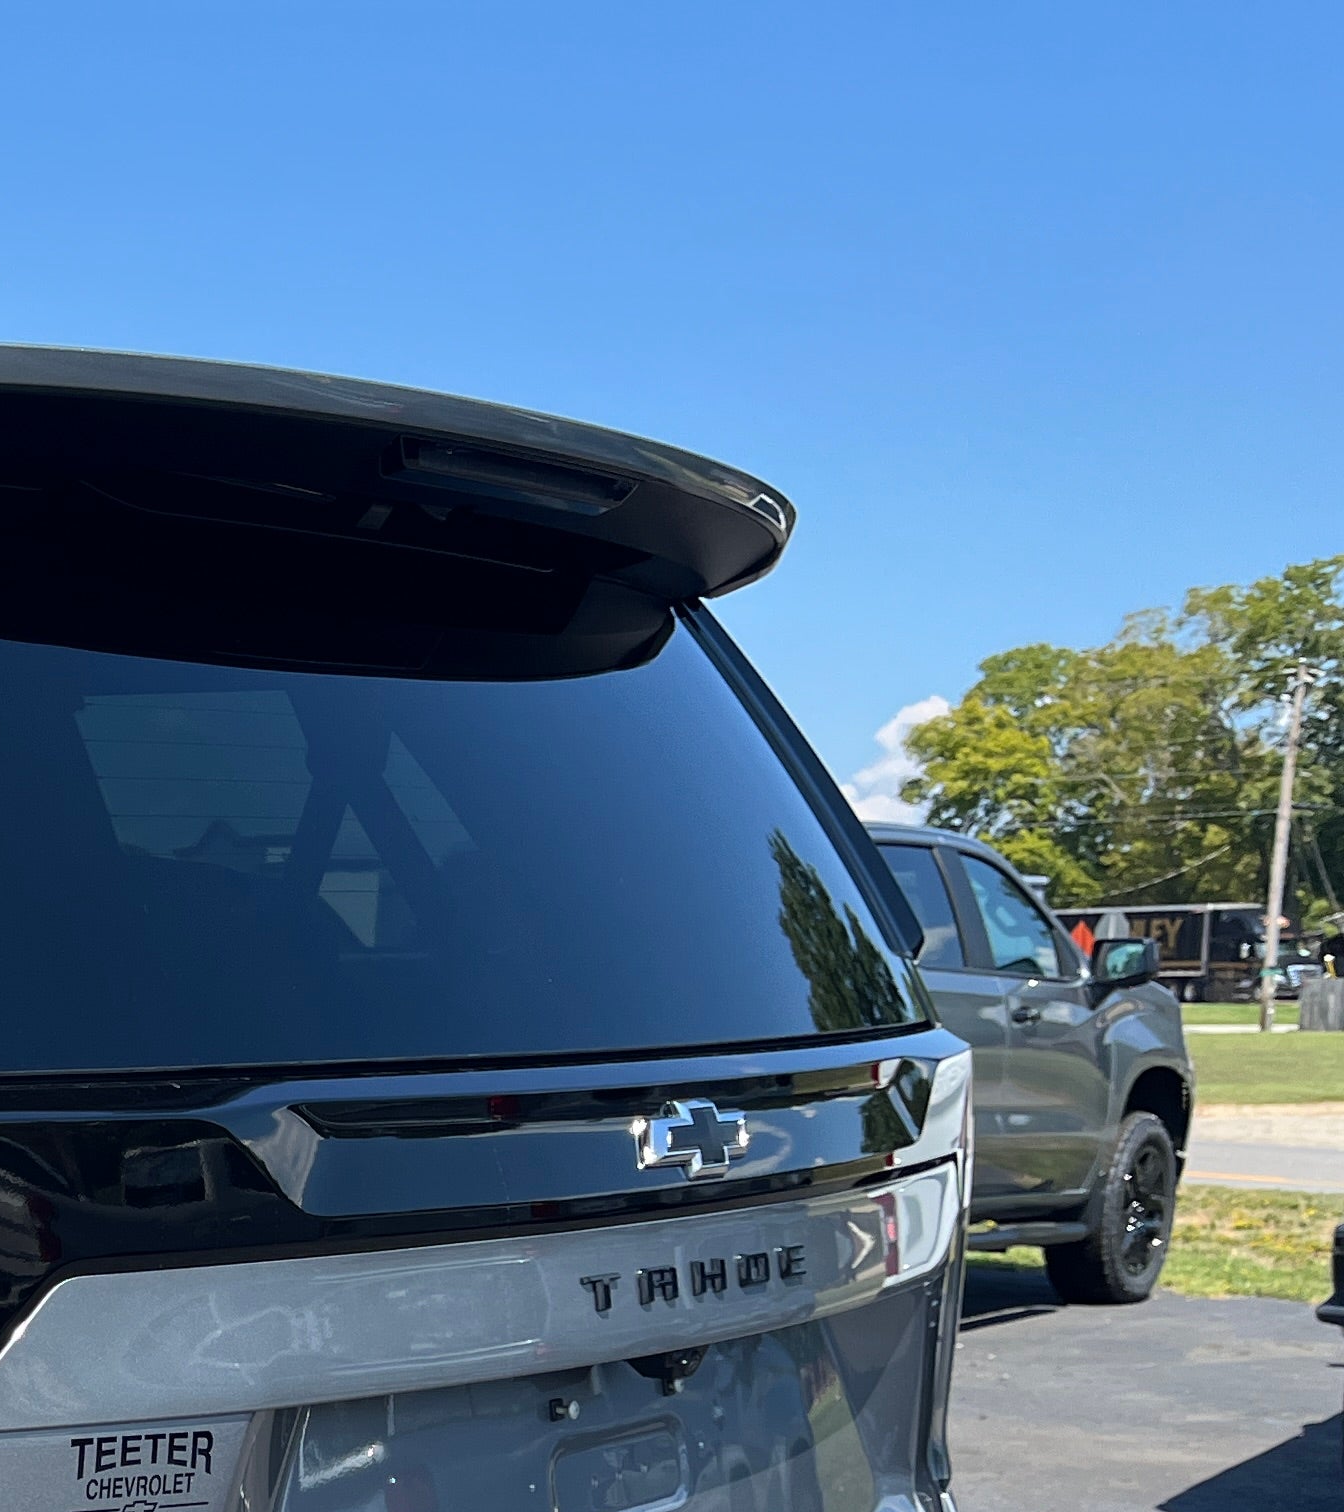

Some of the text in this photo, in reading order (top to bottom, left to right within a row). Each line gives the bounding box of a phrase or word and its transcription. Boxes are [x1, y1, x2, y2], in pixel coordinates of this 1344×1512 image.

[579, 1245, 808, 1313] TAHOE
[70, 1430, 214, 1480] TEETER
[86, 1472, 195, 1500] CHEVROLET
